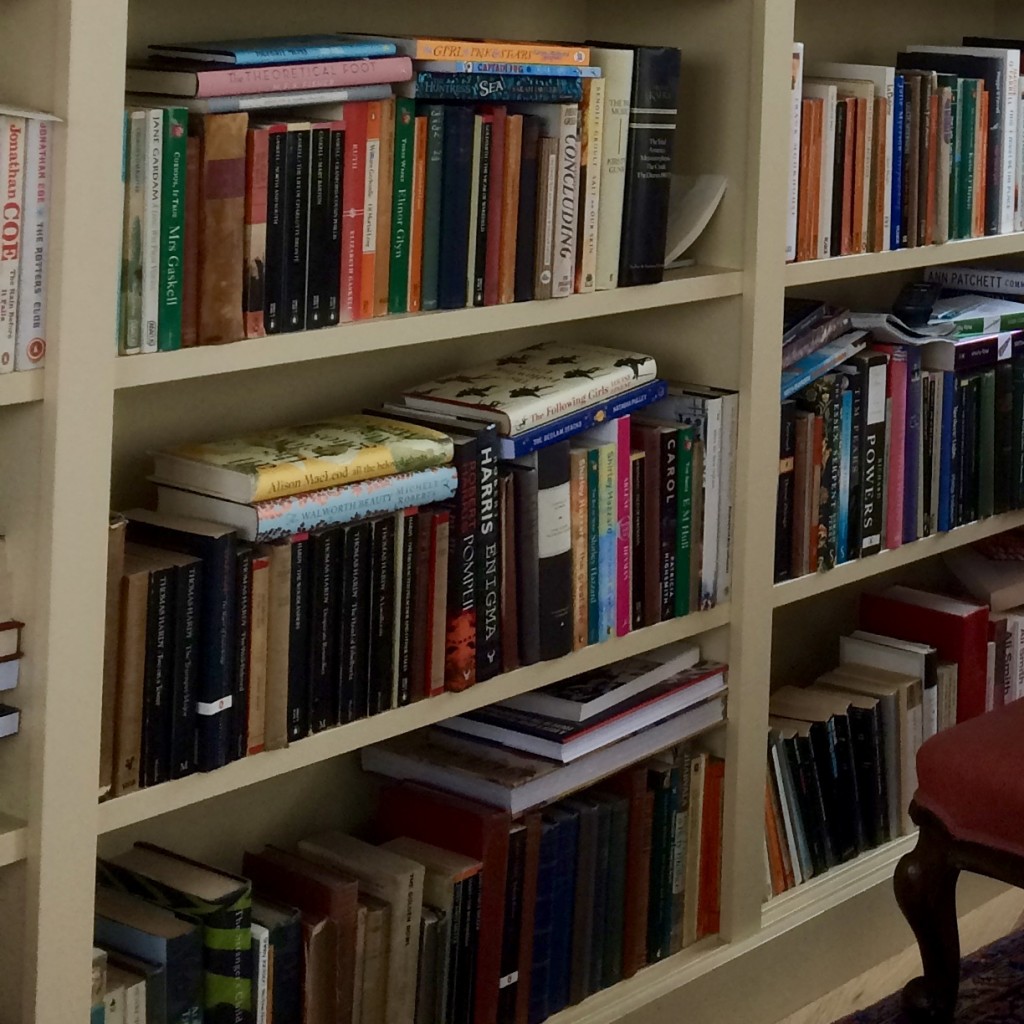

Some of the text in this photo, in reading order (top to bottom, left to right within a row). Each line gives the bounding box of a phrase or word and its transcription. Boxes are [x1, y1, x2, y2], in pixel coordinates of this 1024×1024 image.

[245, 66, 337, 82] THEORETICAL
[343, 60, 377, 75] FOOT
[479, 79, 505, 97] SEA
[1, 124, 22, 261] Jonathan COE
[150, 117, 162, 201] JANE GARDAM
[560, 133, 578, 259] CONCLUDING
[36, 222, 44, 243] THE
[165, 225, 182, 306] Mrs Gaskell
[927, 271, 948, 285] ANN
[950, 272, 1003, 290] PATCHETT
[546, 394, 587, 419] Following
[588, 385, 610, 405] Girls
[269, 480, 301, 495] Alison
[665, 439, 676, 504] CAROL
[829, 403, 841, 508] ESSEX SERPENT
[864, 434, 877, 529] POWERS
[461, 534, 476, 611] POMPEII
[480, 447, 498, 641] HARRIS ENIGMA
[1003, 631, 1014, 697] Ali Smith
